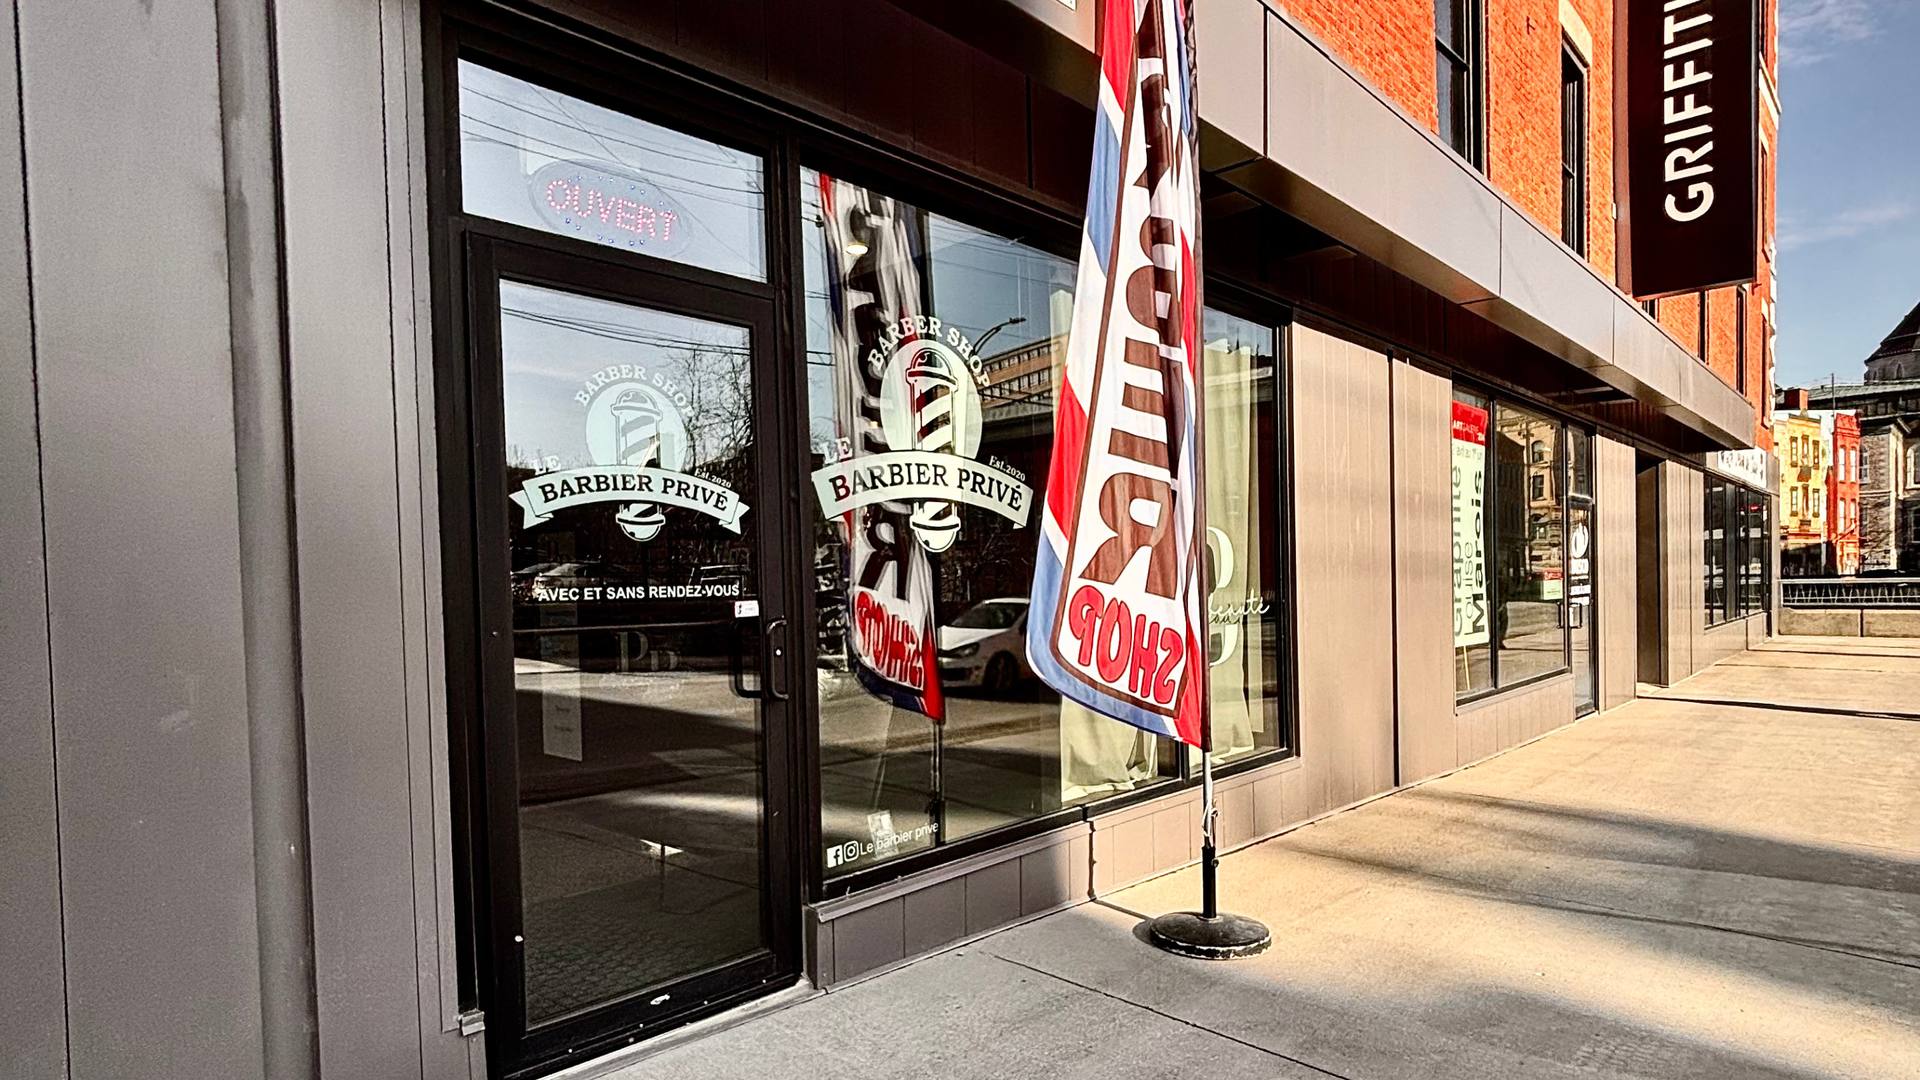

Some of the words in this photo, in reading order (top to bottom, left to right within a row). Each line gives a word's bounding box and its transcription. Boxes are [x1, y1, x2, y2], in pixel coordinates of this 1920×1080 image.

[1663, 0, 1715, 222] GRIFFIT
[547, 179, 678, 241] OUVERT
[867, 315, 942, 371] BARBER
[946, 327, 991, 387] SHOP
[574, 364, 648, 406] BARBER
[652, 372, 695, 417] SHOP
[532, 455, 562, 476] LE
[821, 437, 853, 465] LE
[538, 474, 654, 504] BARBIER
[661, 477, 729, 512] PRIVÉ
[828, 462, 949, 502] BARBIER
[956, 467, 1024, 512] PRIVÉ
[1471, 470, 1485, 634] Marois
[538, 587, 580, 602] AVEC
[583, 586, 603, 600] ET
[606, 586, 645, 600] SANS
[648, 584, 740, 599] RENDEZ-VOUS
[860, 842, 874, 855] Le
[876, 830, 914, 850] barbier
